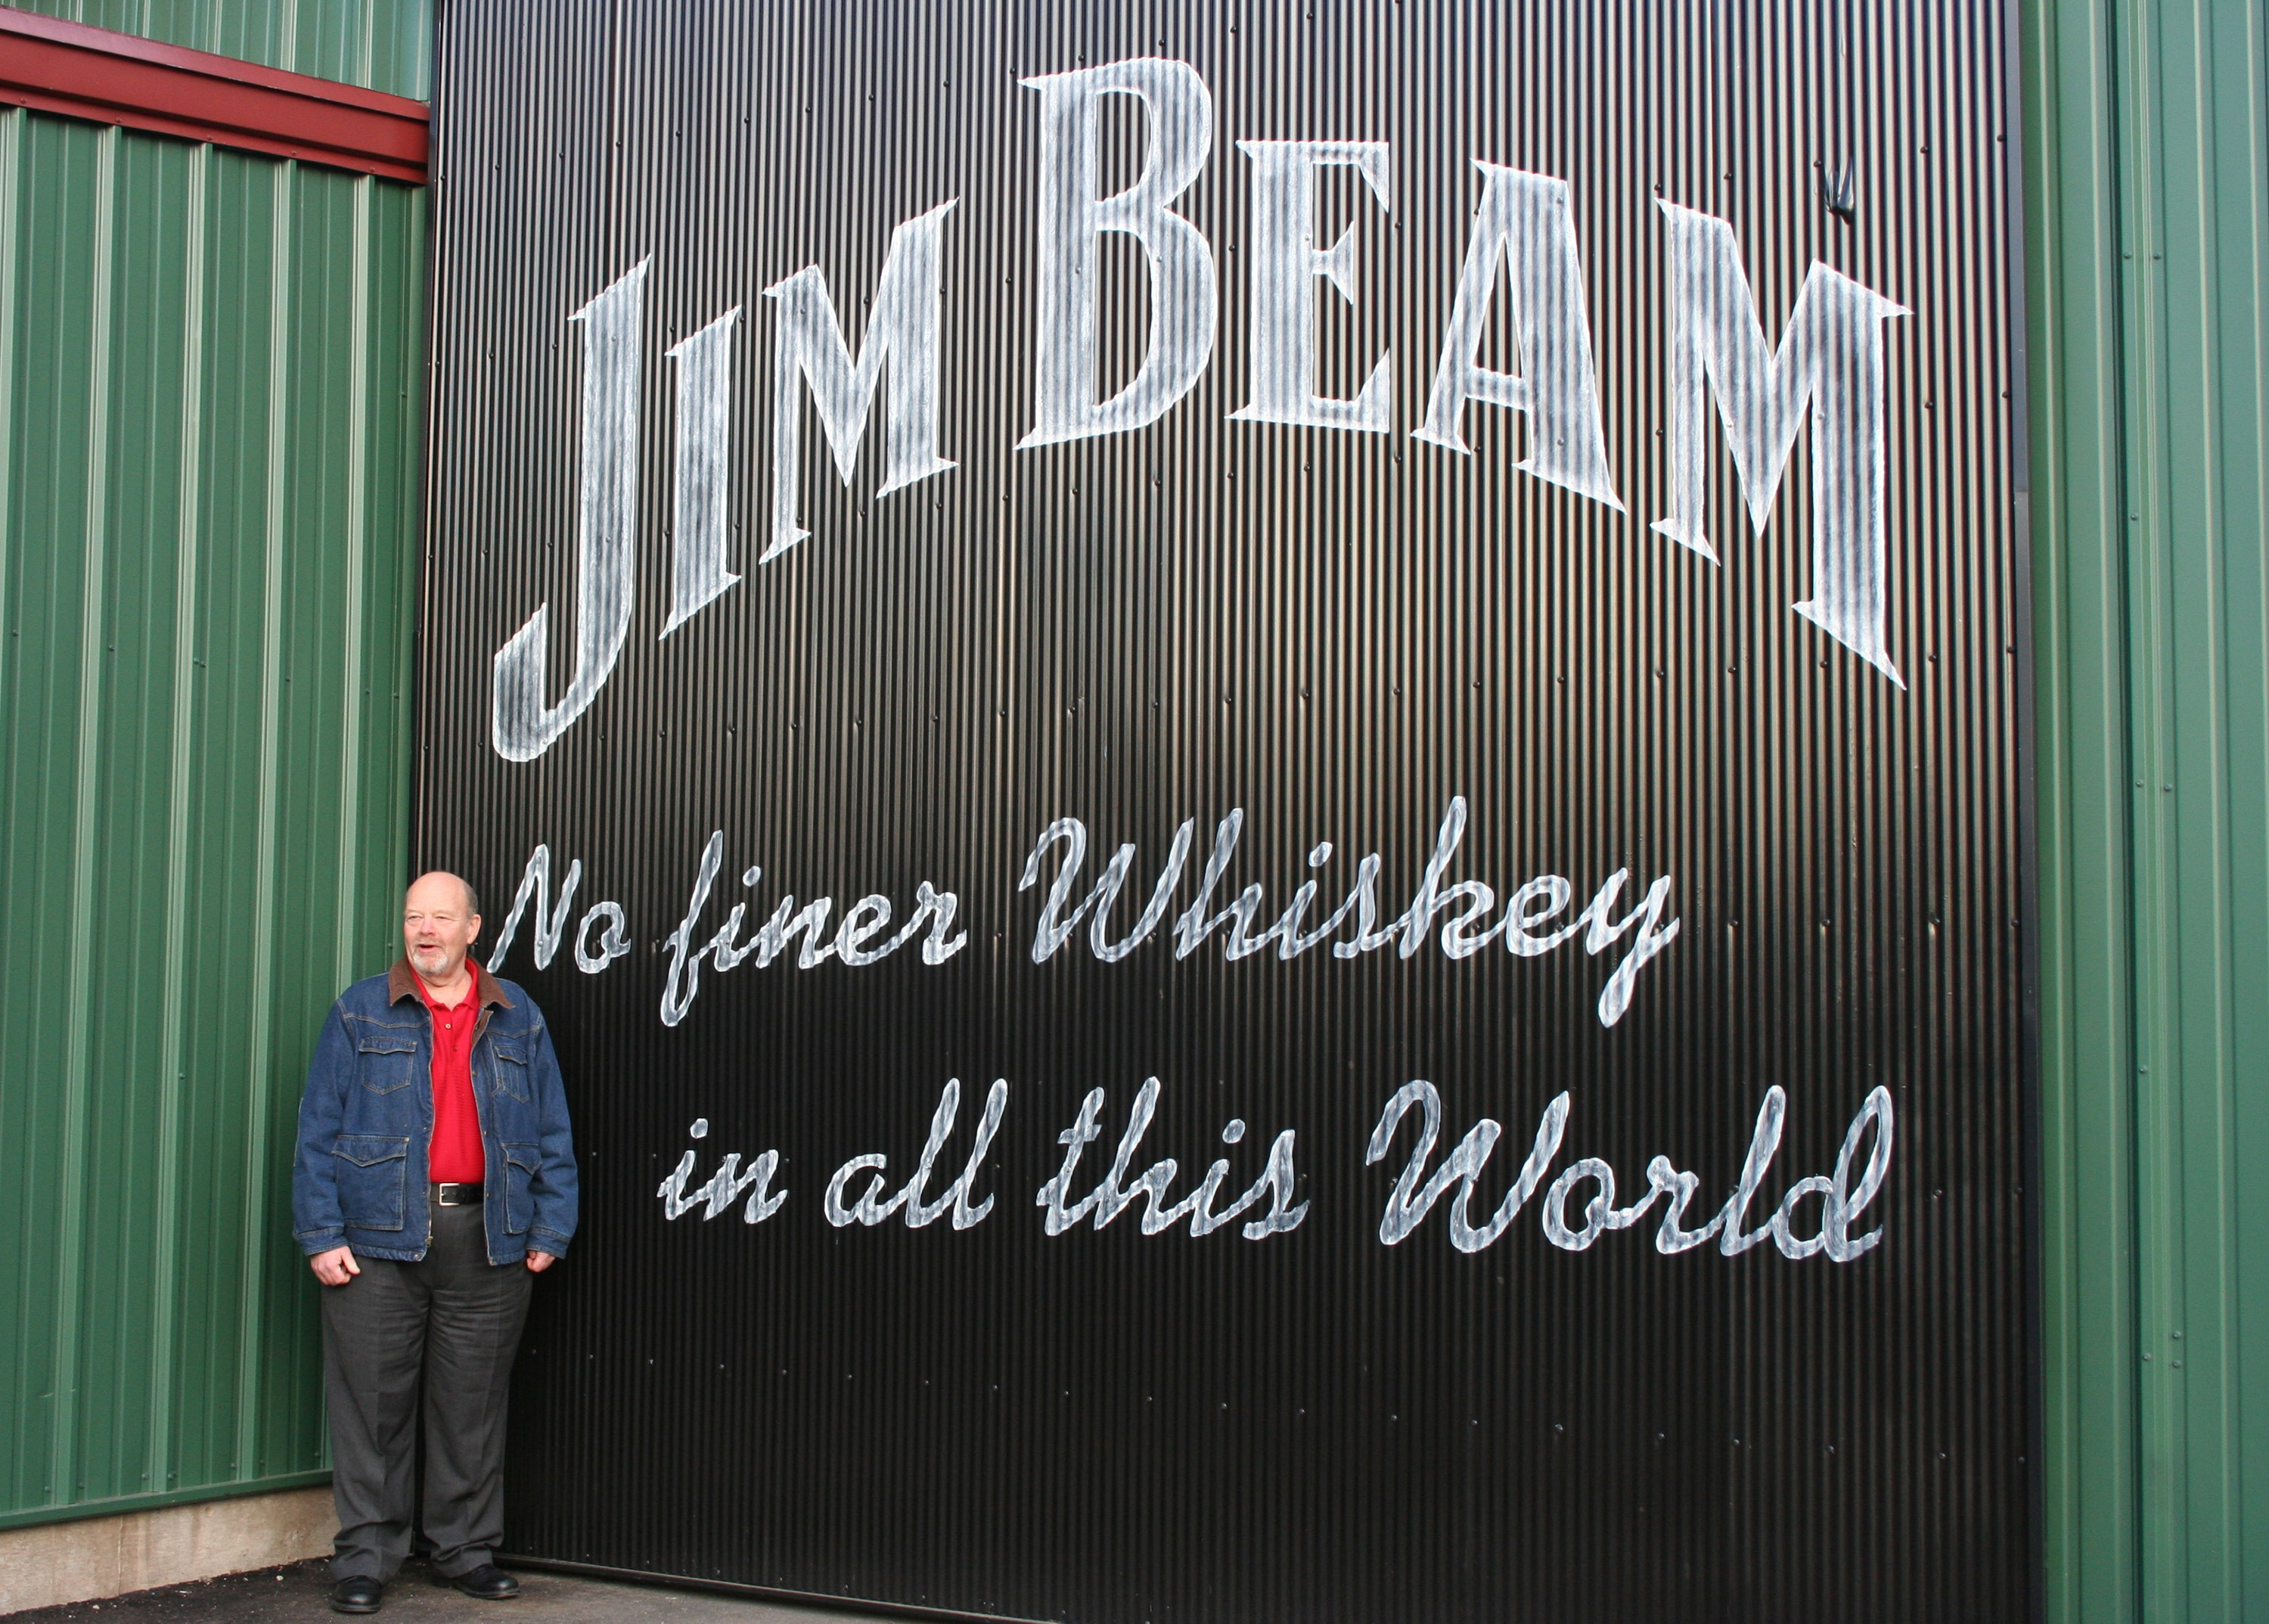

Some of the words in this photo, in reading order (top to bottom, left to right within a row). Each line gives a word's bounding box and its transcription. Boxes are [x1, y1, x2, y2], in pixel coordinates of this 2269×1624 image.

[492, 197, 958, 763] JIM
[1014, 56, 1911, 691] BEAM
[487, 844, 632, 974] No
[660, 829, 967, 1027] finer
[1018, 795, 1681, 1027] Whiskey
[658, 1117, 788, 1224] in
[824, 1077, 1008, 1231] all
[1035, 1076, 1310, 1241] this
[1365, 1079, 1892, 1263] World
